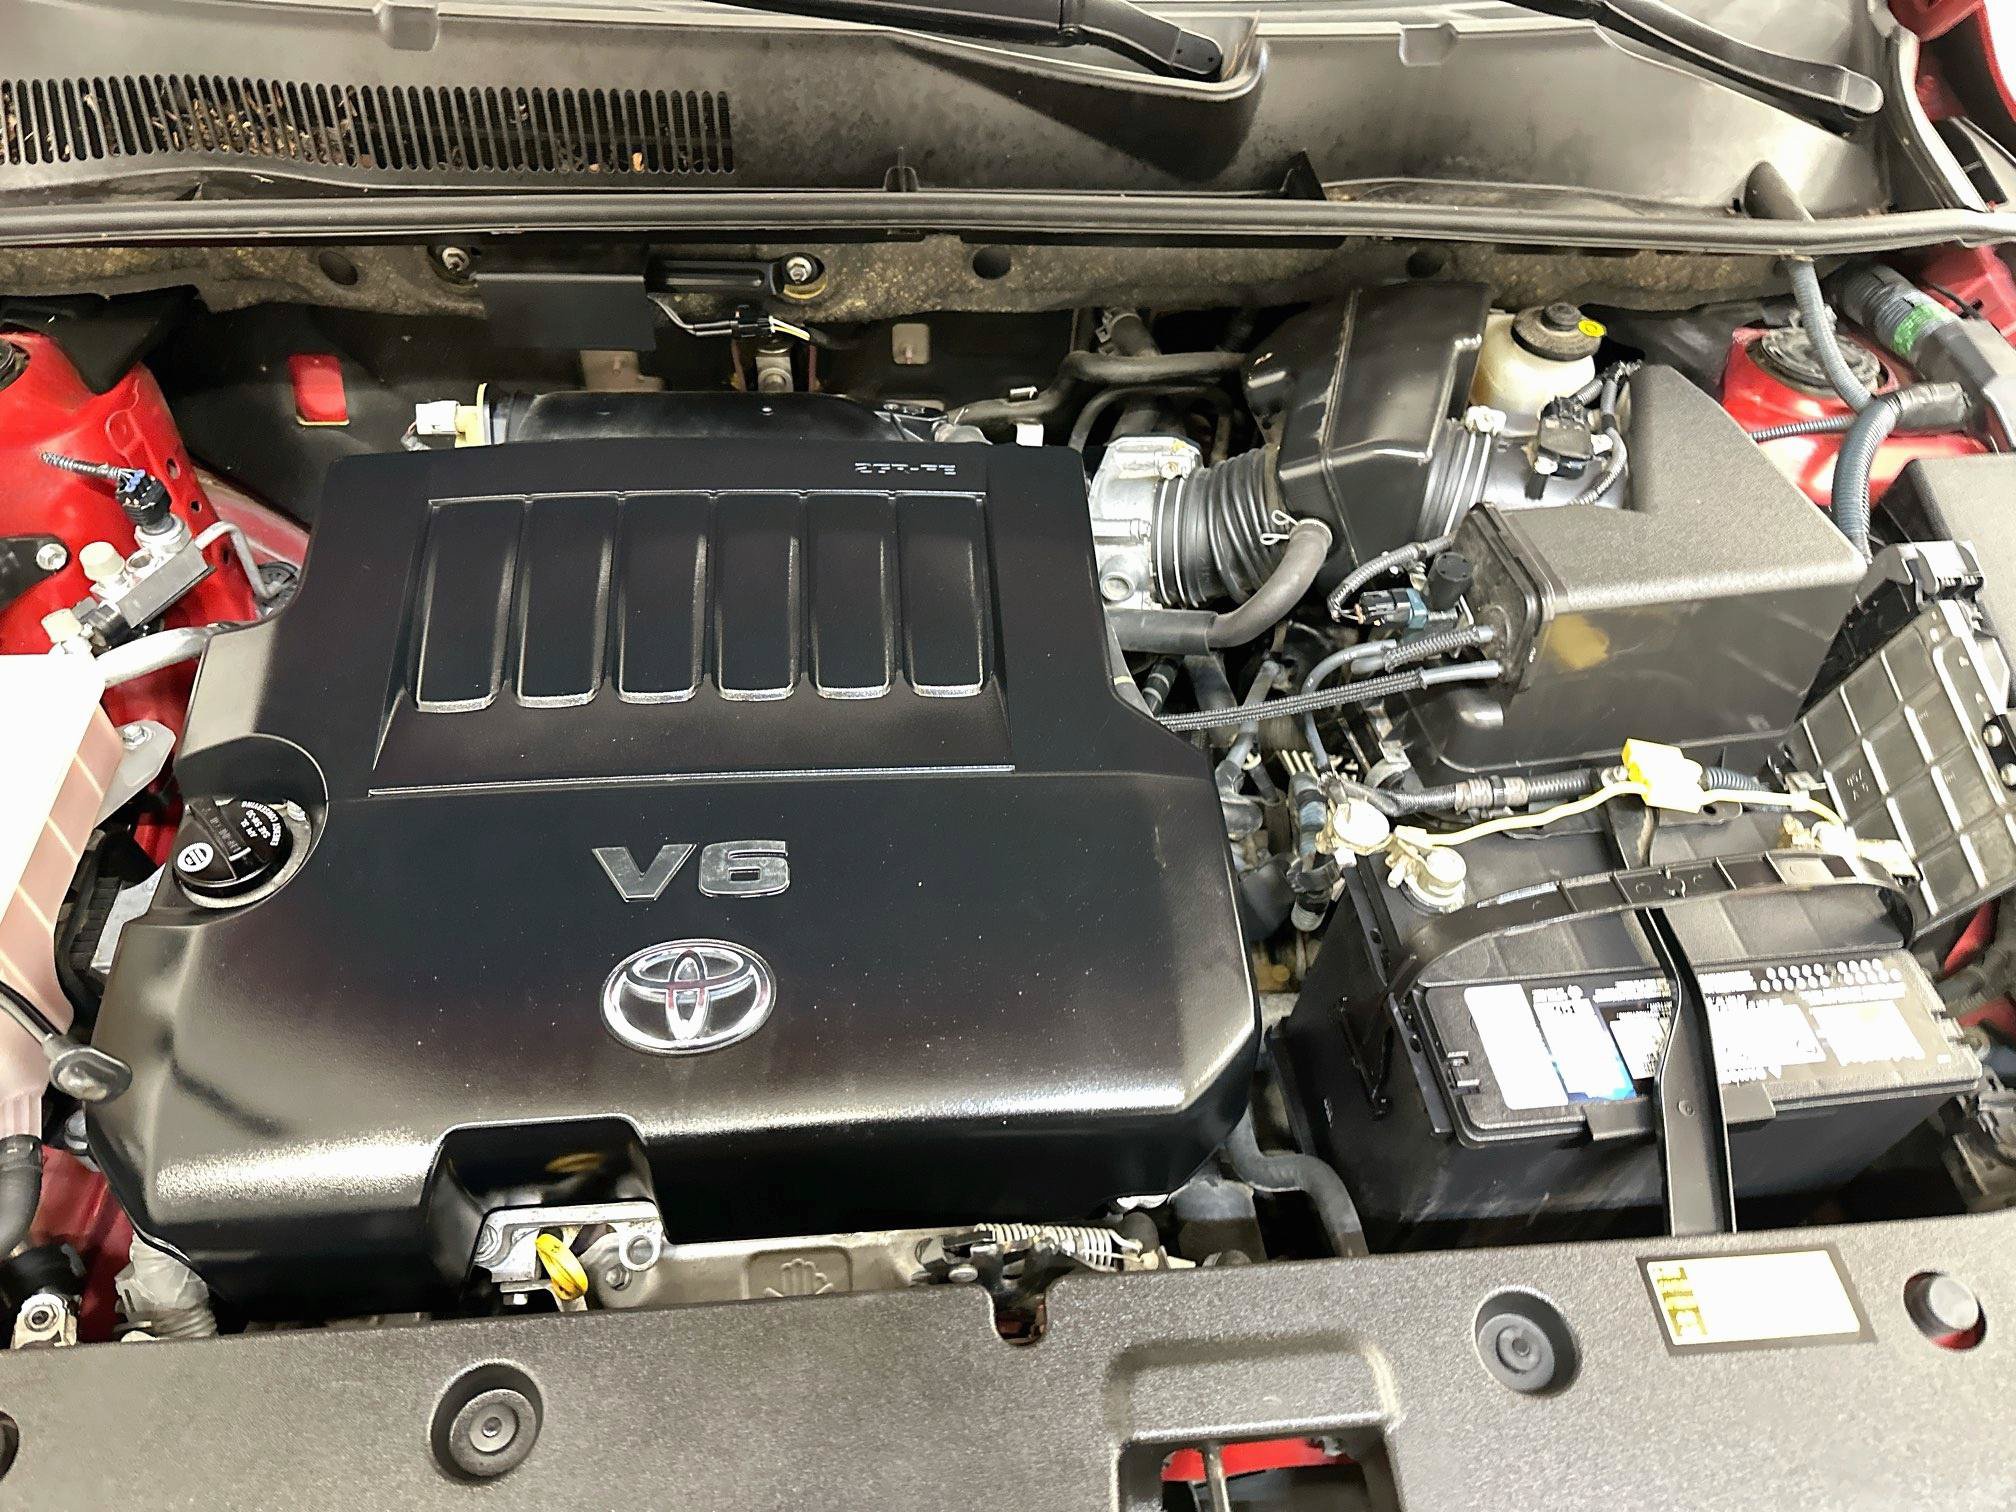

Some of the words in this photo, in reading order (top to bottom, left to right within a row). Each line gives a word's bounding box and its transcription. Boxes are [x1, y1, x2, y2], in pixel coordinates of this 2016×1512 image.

[241, 800, 278, 822] CONSERVING
[258, 826, 271, 839] SAE
[592, 840, 790, 902] V6
